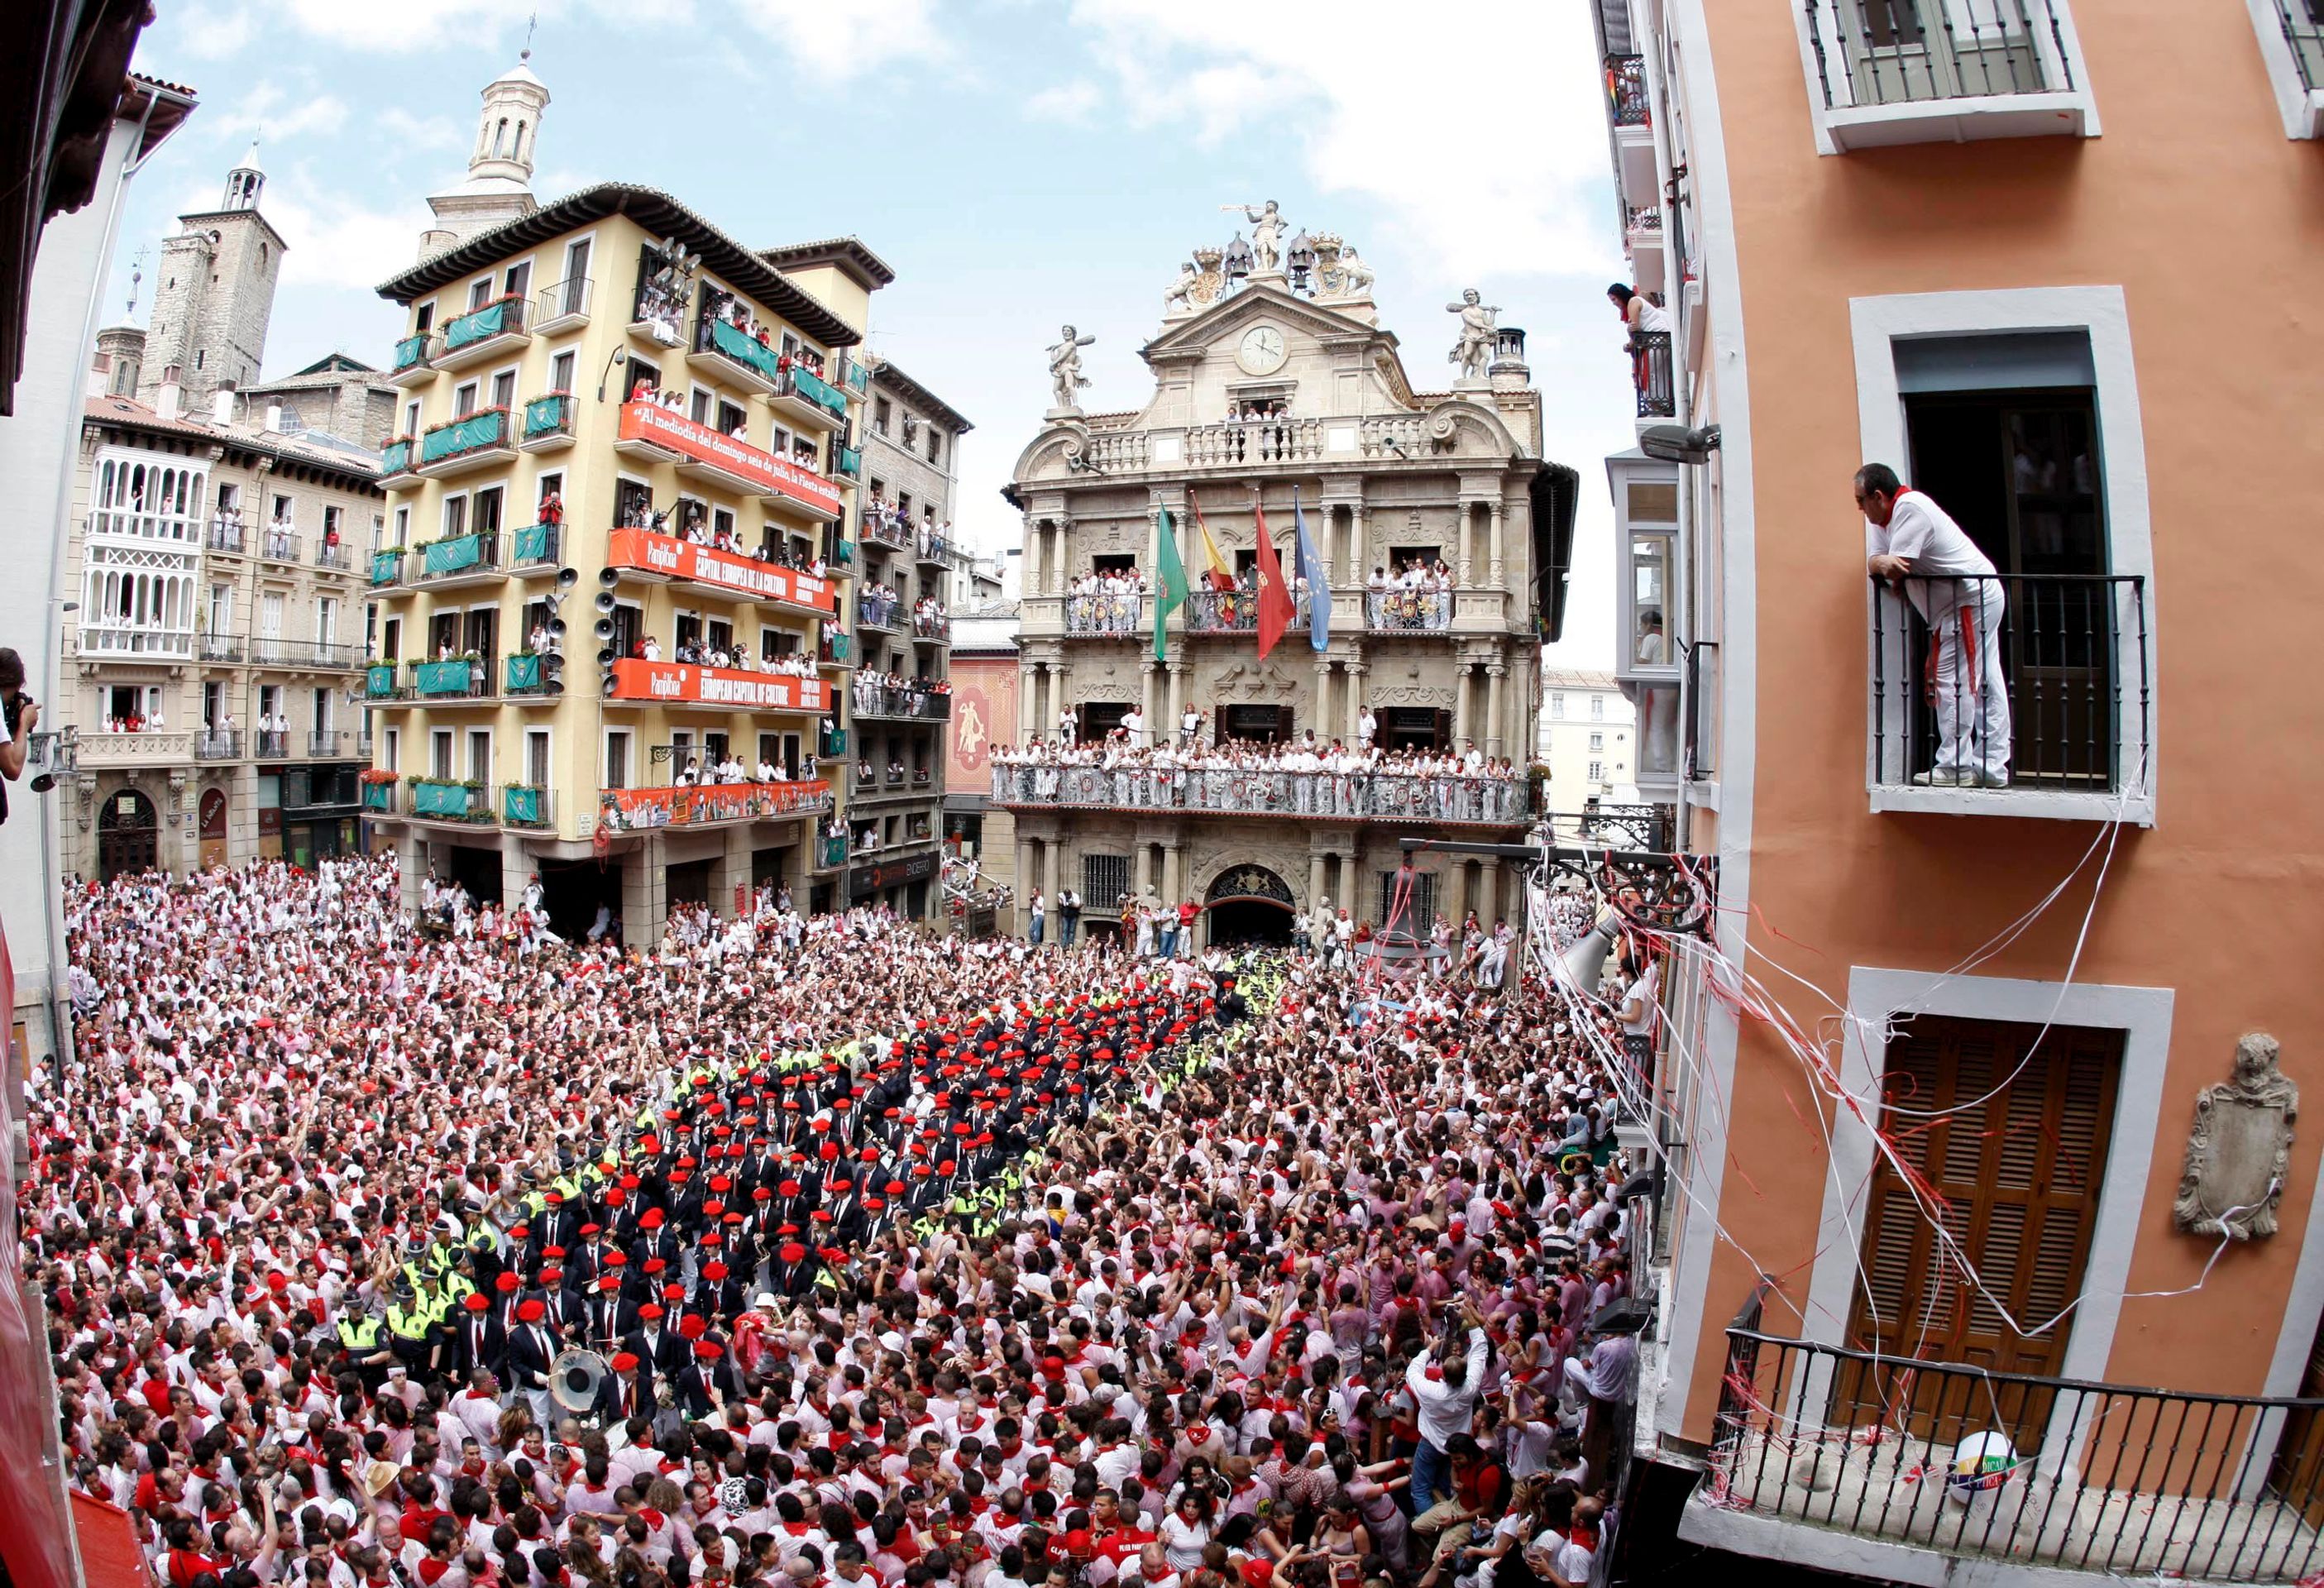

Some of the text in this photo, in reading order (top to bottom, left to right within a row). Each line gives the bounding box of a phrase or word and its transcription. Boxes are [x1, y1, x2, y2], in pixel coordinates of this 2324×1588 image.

[655, 417, 696, 442] mediodía
[697, 430, 712, 447] del
[712, 436, 747, 462] domingo
[748, 454, 762, 469] seis
[763, 458, 772, 472] de
[772, 463, 790, 483] julio,
[791, 469, 797, 484] la
[798, 473, 818, 492] Fiesta
[696, 556, 721, 581] CAPITAL
[721, 562, 748, 587] EUROPEA
[748, 568, 755, 590] DE
[756, 572, 763, 591] LA
[763, 573, 786, 596] CULTURA
[701, 677, 789, 705] EUROPEAN CAPITAL OF CULTURE
